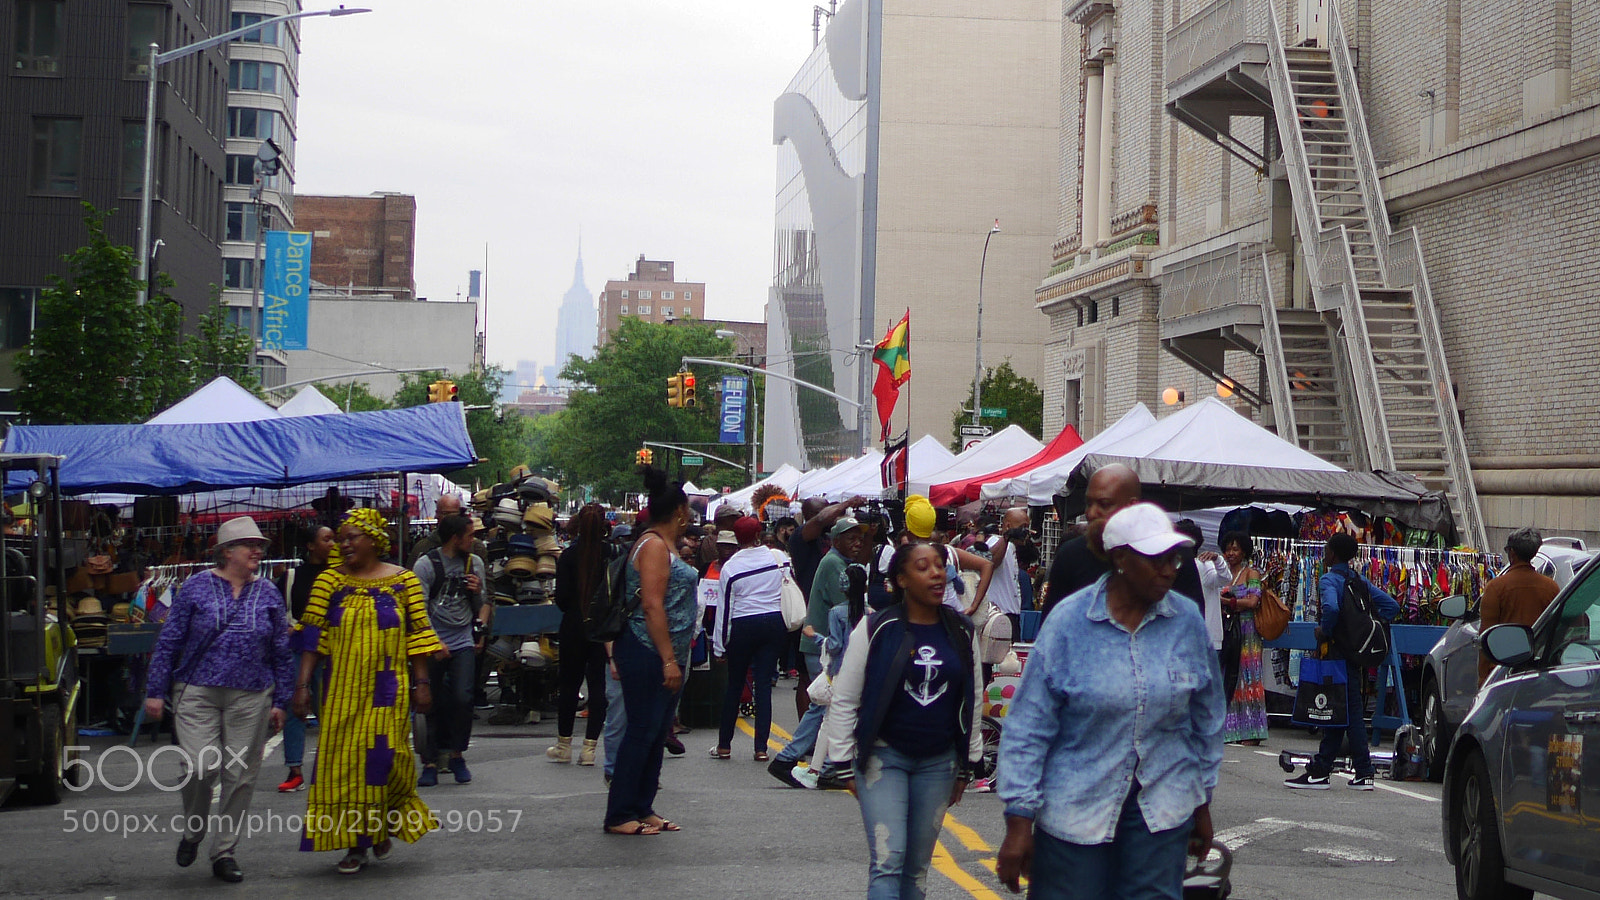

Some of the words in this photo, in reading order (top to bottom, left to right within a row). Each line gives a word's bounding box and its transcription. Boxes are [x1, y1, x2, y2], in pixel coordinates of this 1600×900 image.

[285, 231, 310, 297] Dance
[265, 294, 289, 350] Africa
[724, 390, 742, 433] FULTON
